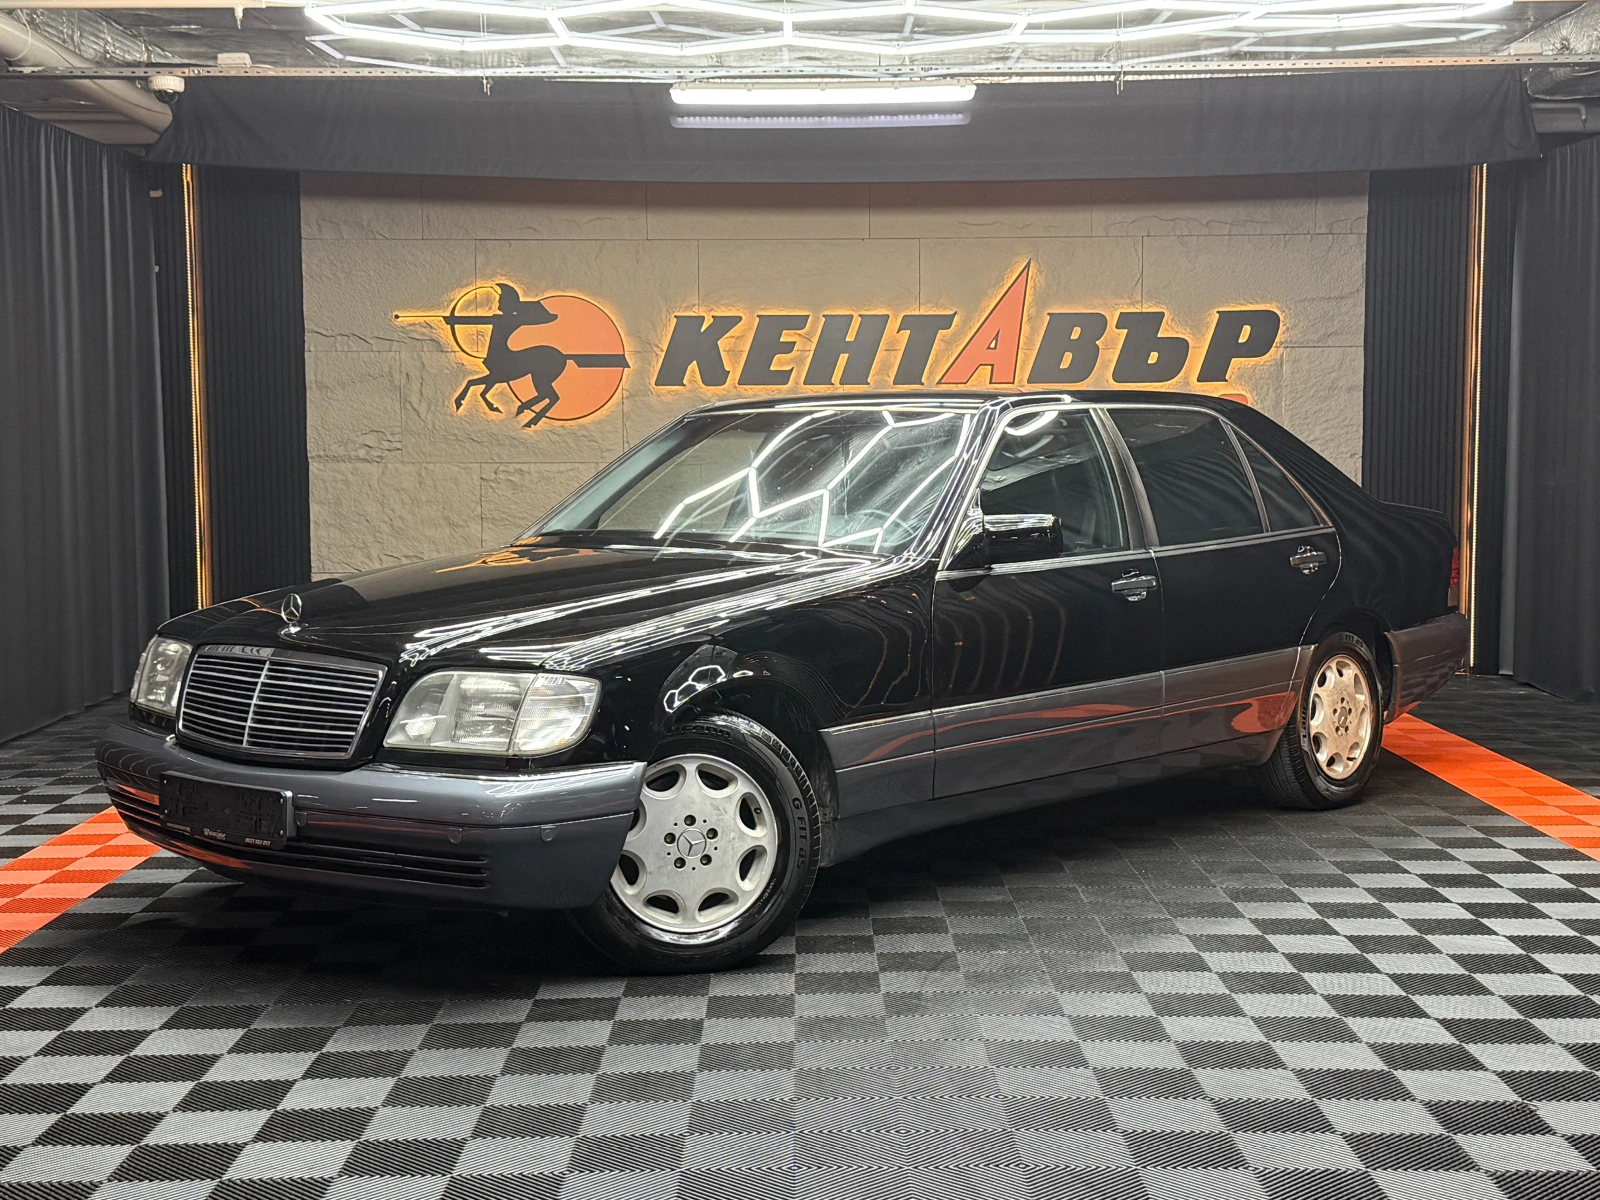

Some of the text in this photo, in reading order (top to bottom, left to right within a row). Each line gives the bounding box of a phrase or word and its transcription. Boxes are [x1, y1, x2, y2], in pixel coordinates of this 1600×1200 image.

[654, 259, 1281, 387] КЕНТАВЪР
[791, 797, 803, 810] G
[796, 816, 808, 843] FIT
